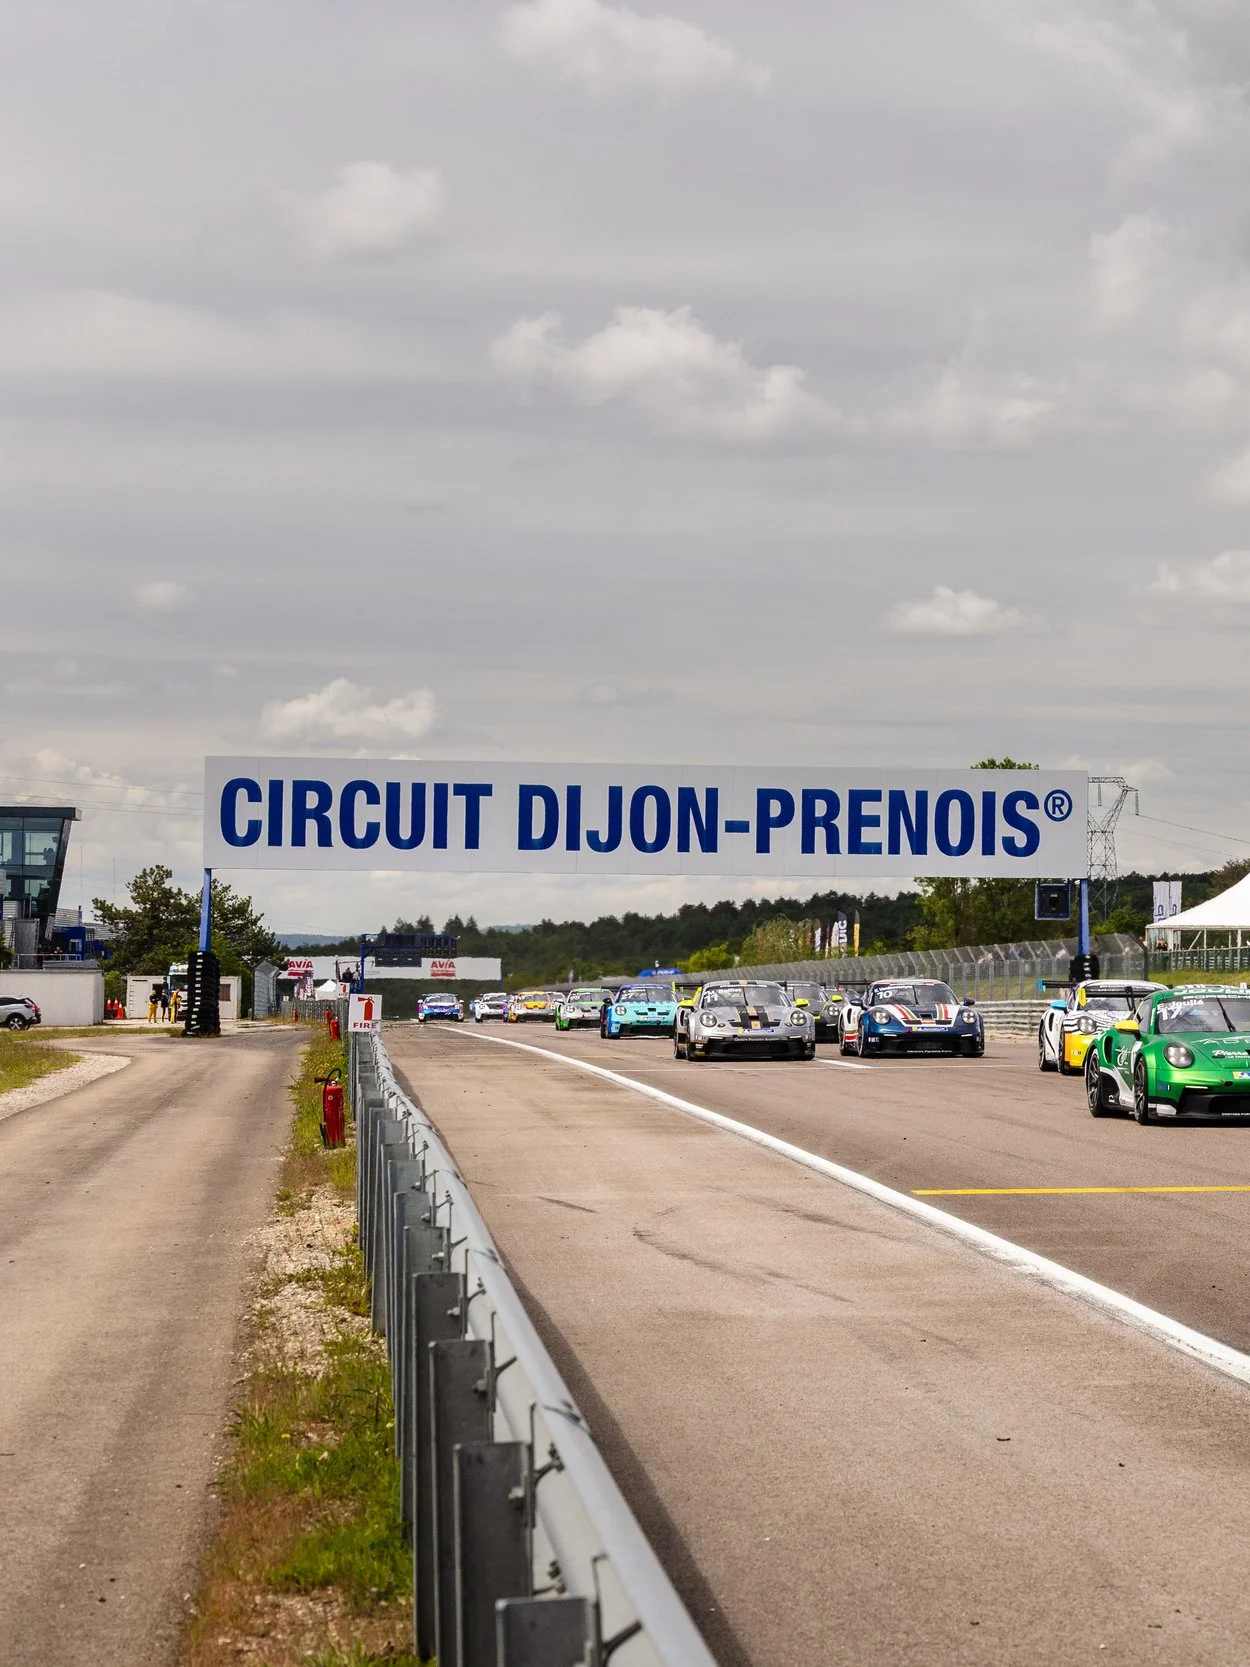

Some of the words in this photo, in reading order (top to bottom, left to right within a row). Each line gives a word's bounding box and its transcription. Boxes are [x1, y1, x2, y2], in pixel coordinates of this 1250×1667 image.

[220, 777, 492, 850] CIRCUIT
[430, 961, 456, 969] AVIA
[703, 993, 718, 1003] 11
[877, 991, 893, 999] 10
[1168, 999, 1204, 1008] Joulié
[1157, 1007, 1182, 1021] 17
[1212, 1049, 1247, 1057] Pierre
